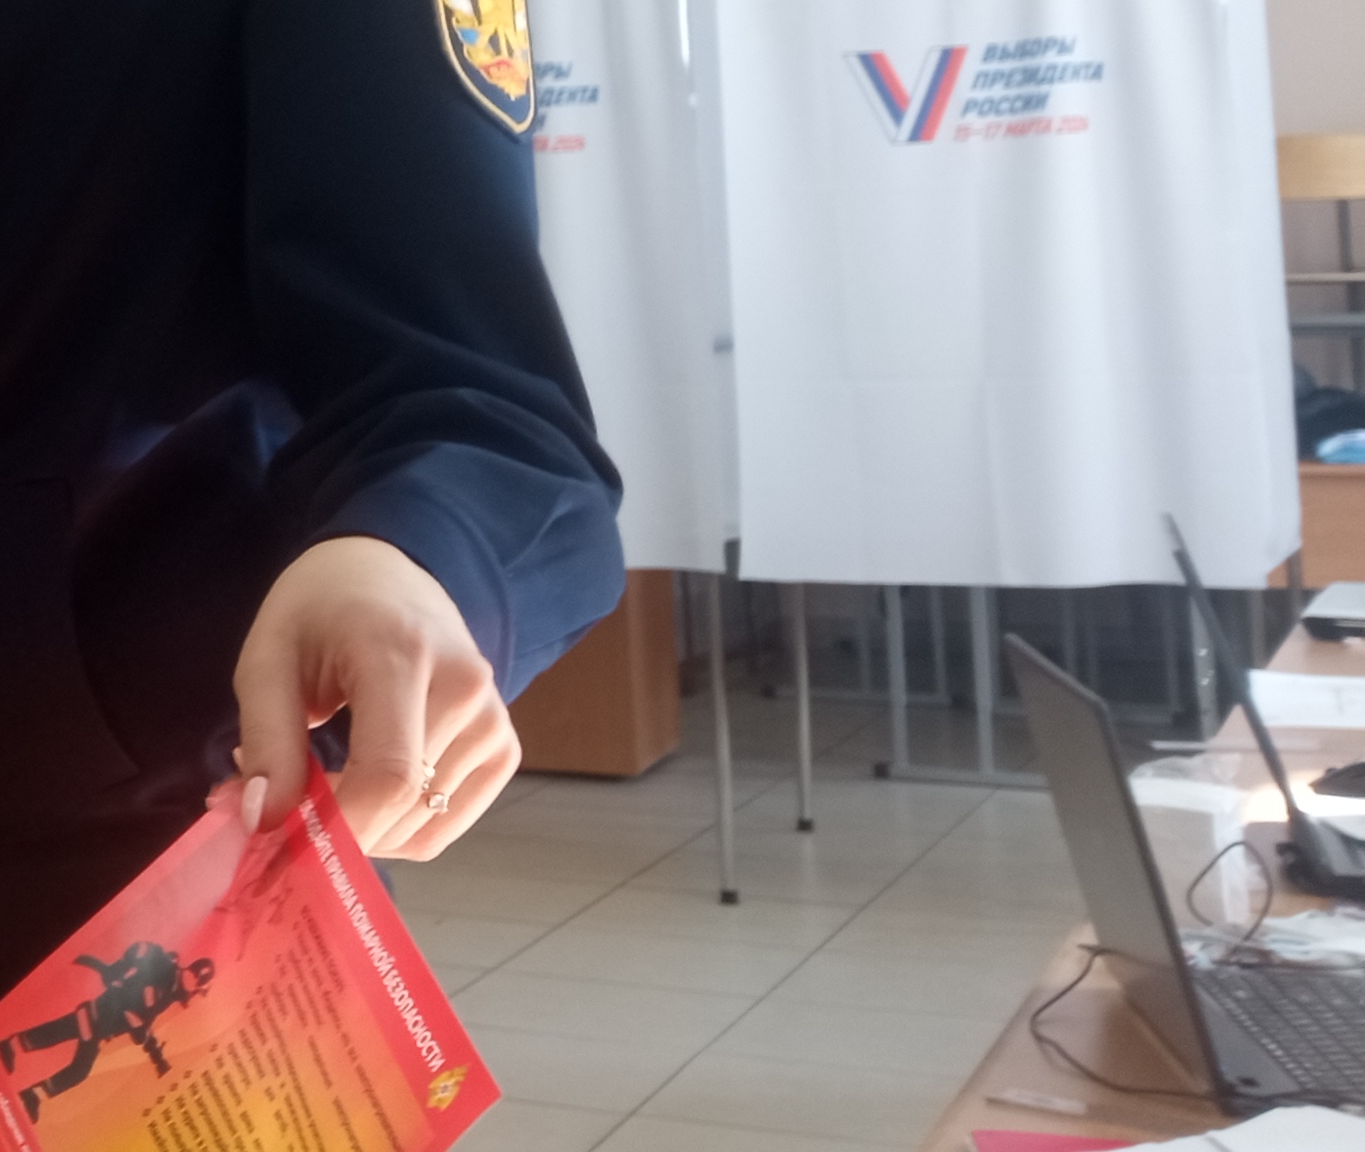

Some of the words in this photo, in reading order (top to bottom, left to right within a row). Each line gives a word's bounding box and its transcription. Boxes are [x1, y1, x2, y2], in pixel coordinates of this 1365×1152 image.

[982, 35, 1077, 65] ВЫБОРЫ
[970, 61, 1105, 93] ПРЕЗИДЕНТА
[960, 91, 1050, 119] РОССИИ
[348, 901, 397, 978] ПОЖАРНОЙ
[382, 968, 446, 1074] БЕЗОПАСНОСТИ
